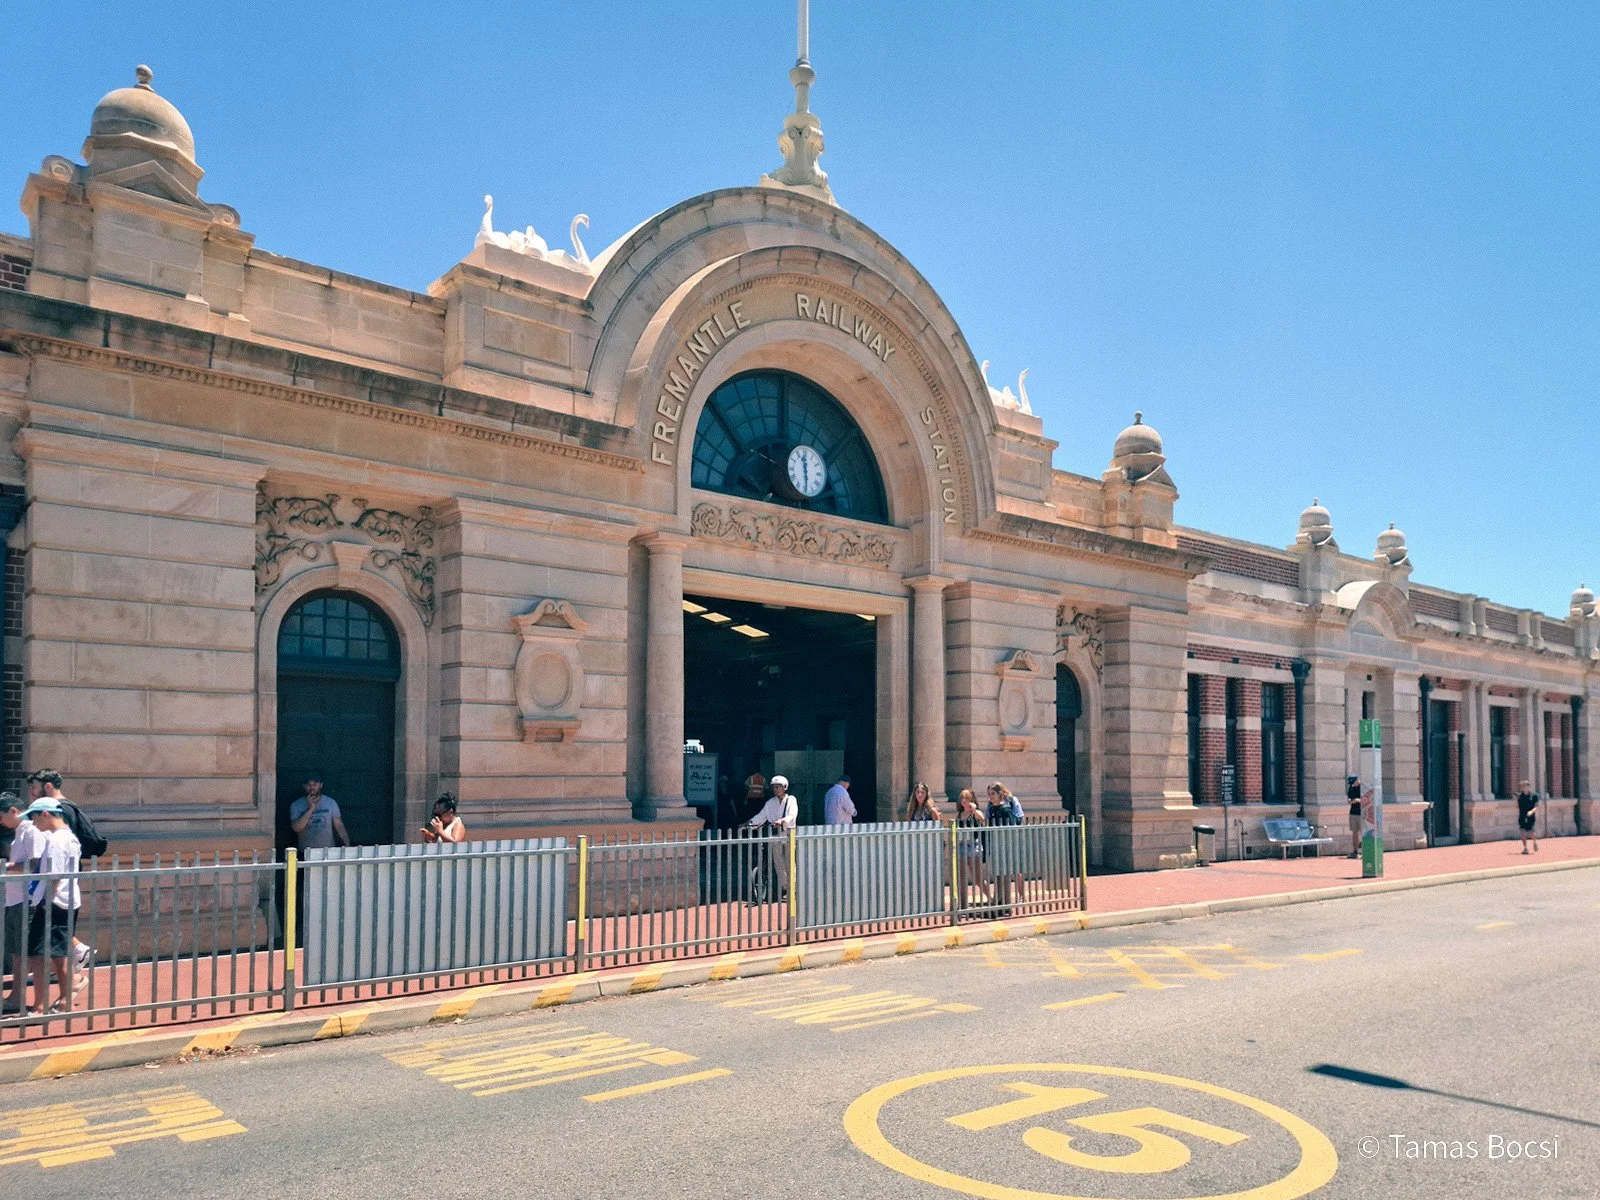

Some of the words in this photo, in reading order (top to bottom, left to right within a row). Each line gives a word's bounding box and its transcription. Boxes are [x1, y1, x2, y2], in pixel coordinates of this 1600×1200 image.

[651, 300, 751, 466] FREMANTLE
[796, 293, 896, 363] RAILWAY
[920, 406, 957, 526] STATION
[752, 990, 984, 1033] NOT
[944, 1081, 1251, 1174] 15
